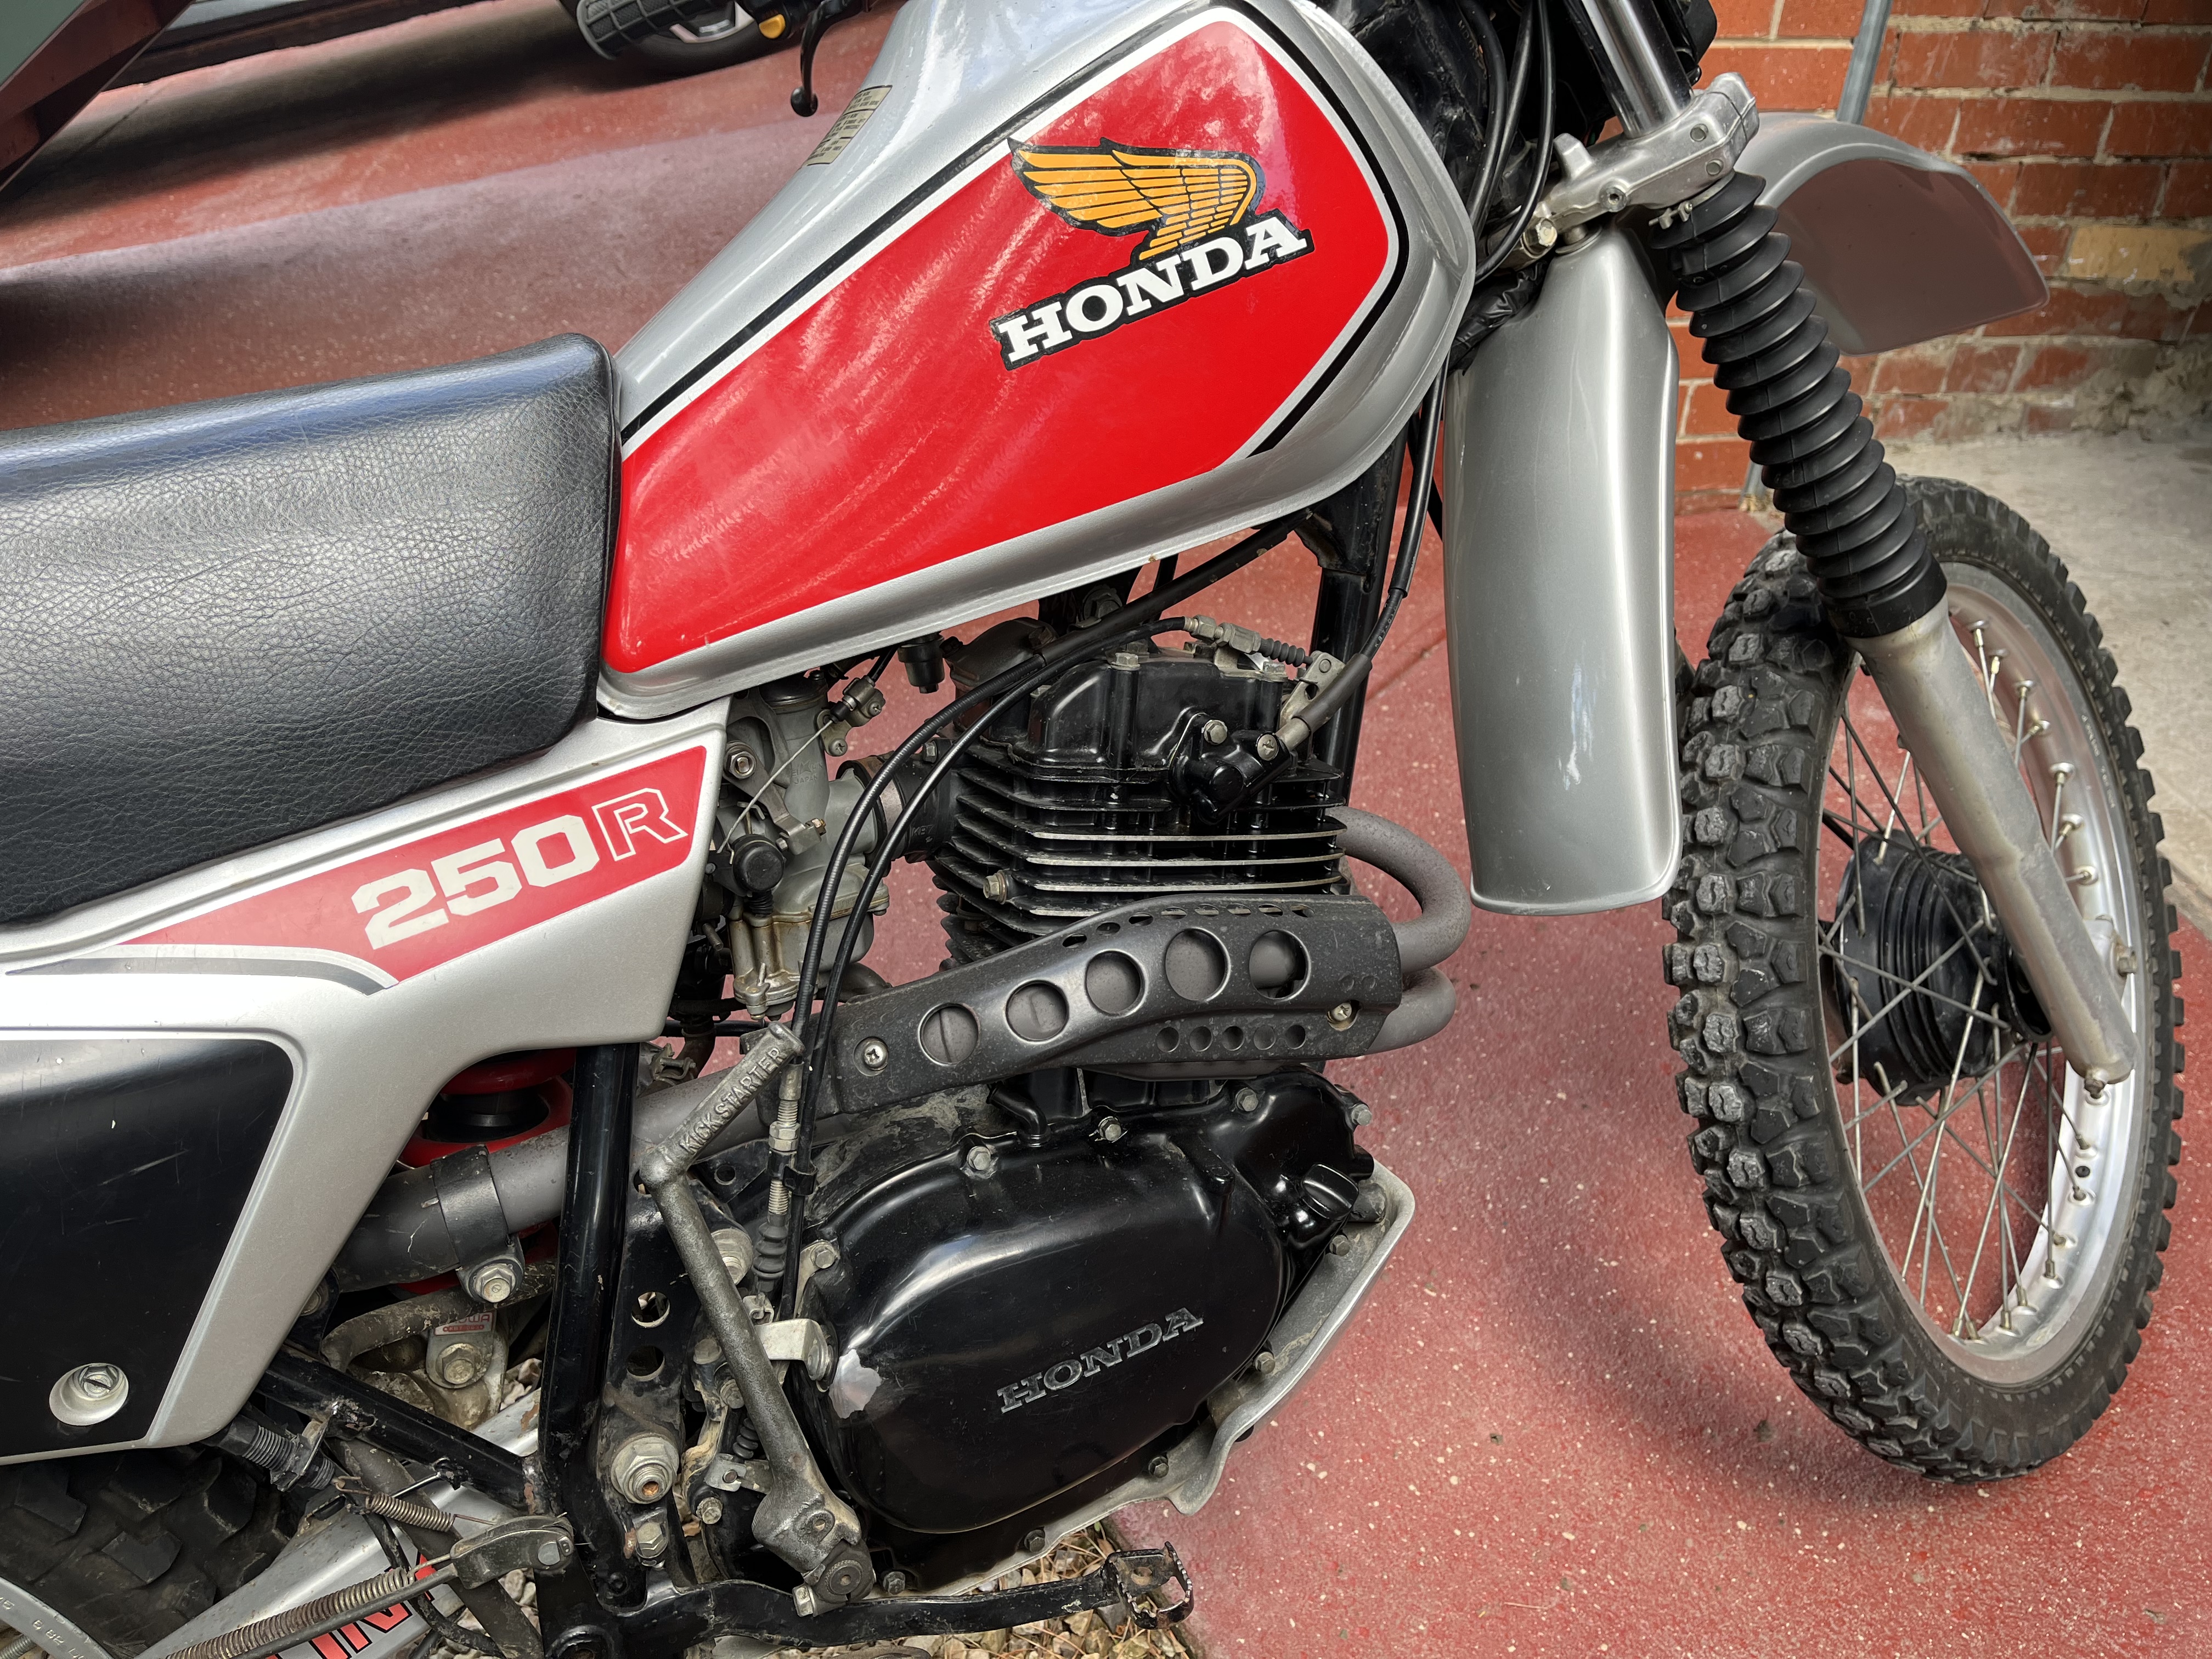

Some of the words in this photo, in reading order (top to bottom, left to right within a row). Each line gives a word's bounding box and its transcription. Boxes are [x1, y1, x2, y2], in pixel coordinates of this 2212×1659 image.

[998, 216, 1307, 363] HONDA
[794, 774, 817, 785] JAPAN
[679, 1113, 723, 1155] KICK
[714, 1047, 788, 1120] STARTER
[997, 1307, 1204, 1414] HONDA
